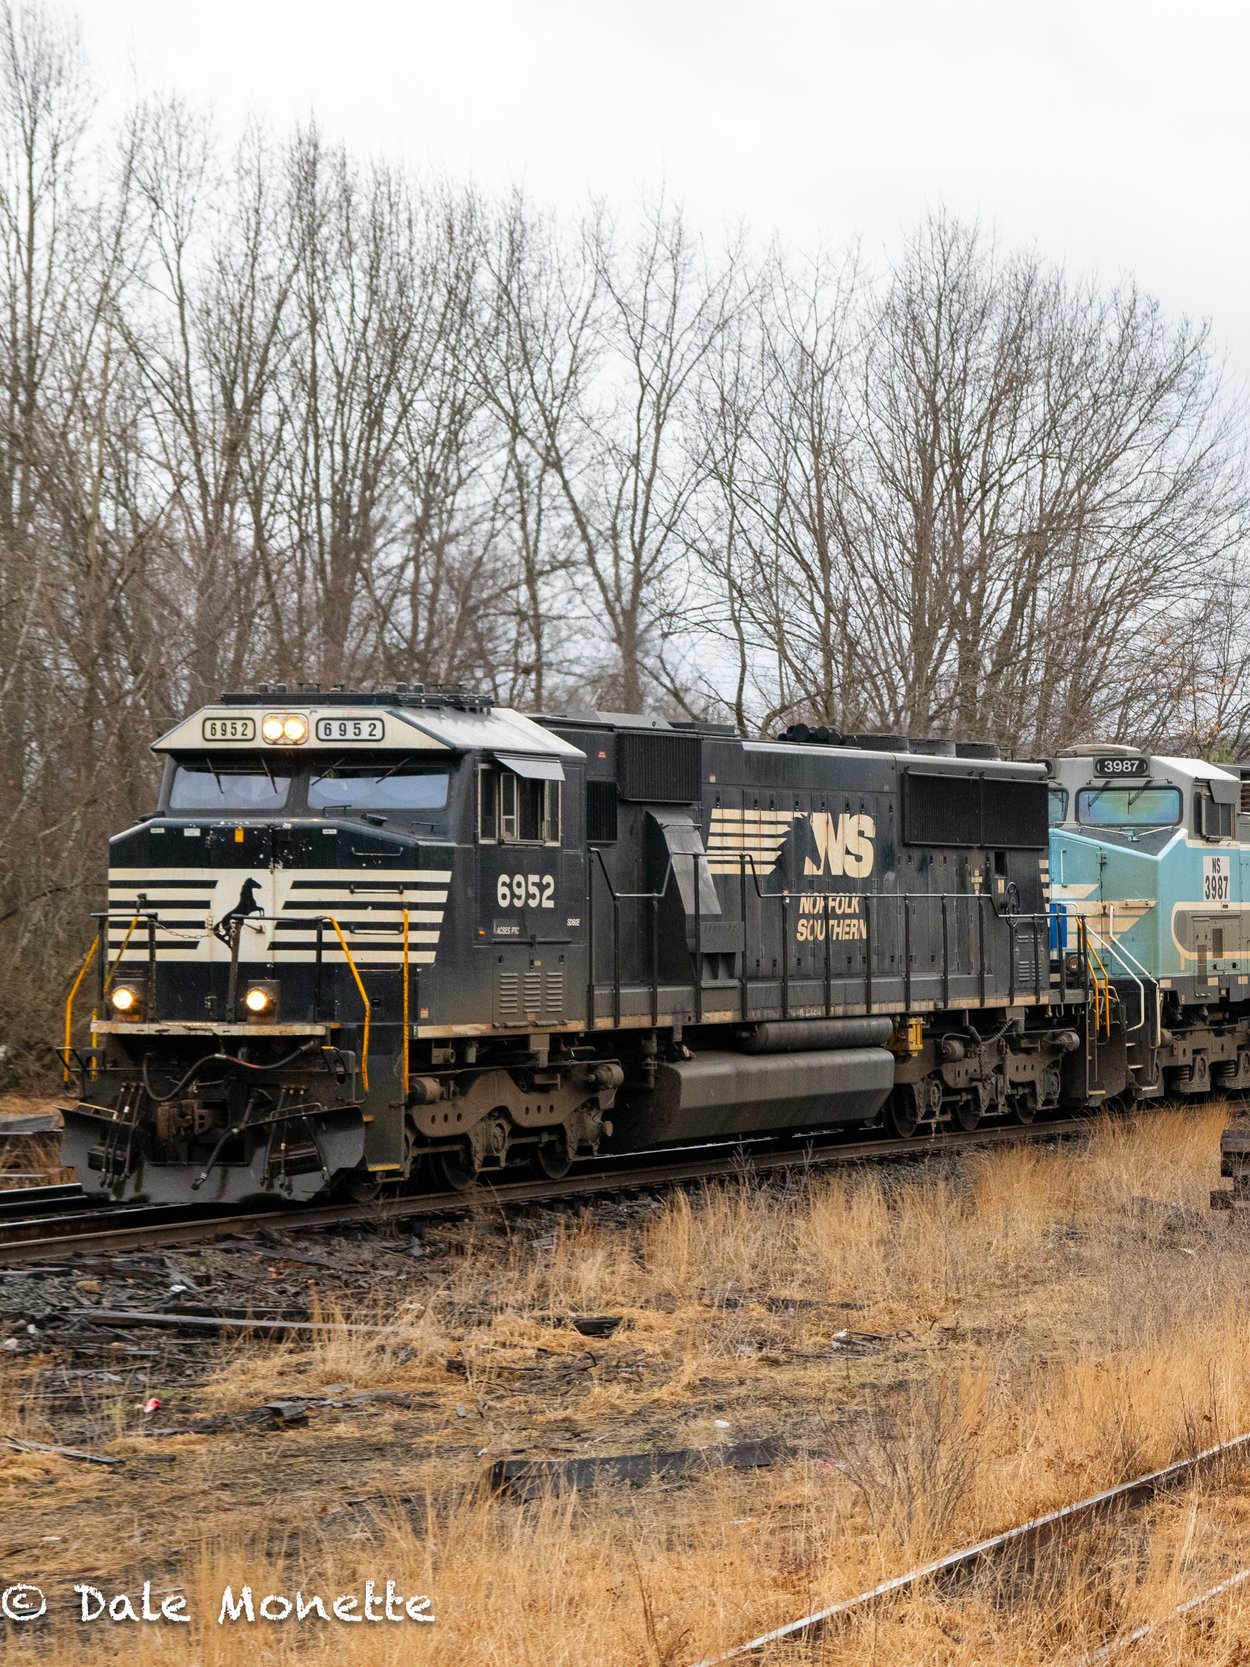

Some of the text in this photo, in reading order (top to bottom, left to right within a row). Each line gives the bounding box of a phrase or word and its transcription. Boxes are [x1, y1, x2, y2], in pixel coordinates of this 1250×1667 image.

[210, 722, 249, 737] 6952
[323, 722, 377, 737] 6952
[1104, 760, 1140, 772] 3987
[803, 812, 876, 878] NS
[1211, 857, 1221, 874] NS
[497, 873, 555, 908] 6952
[1205, 875, 1229, 900] 3987
